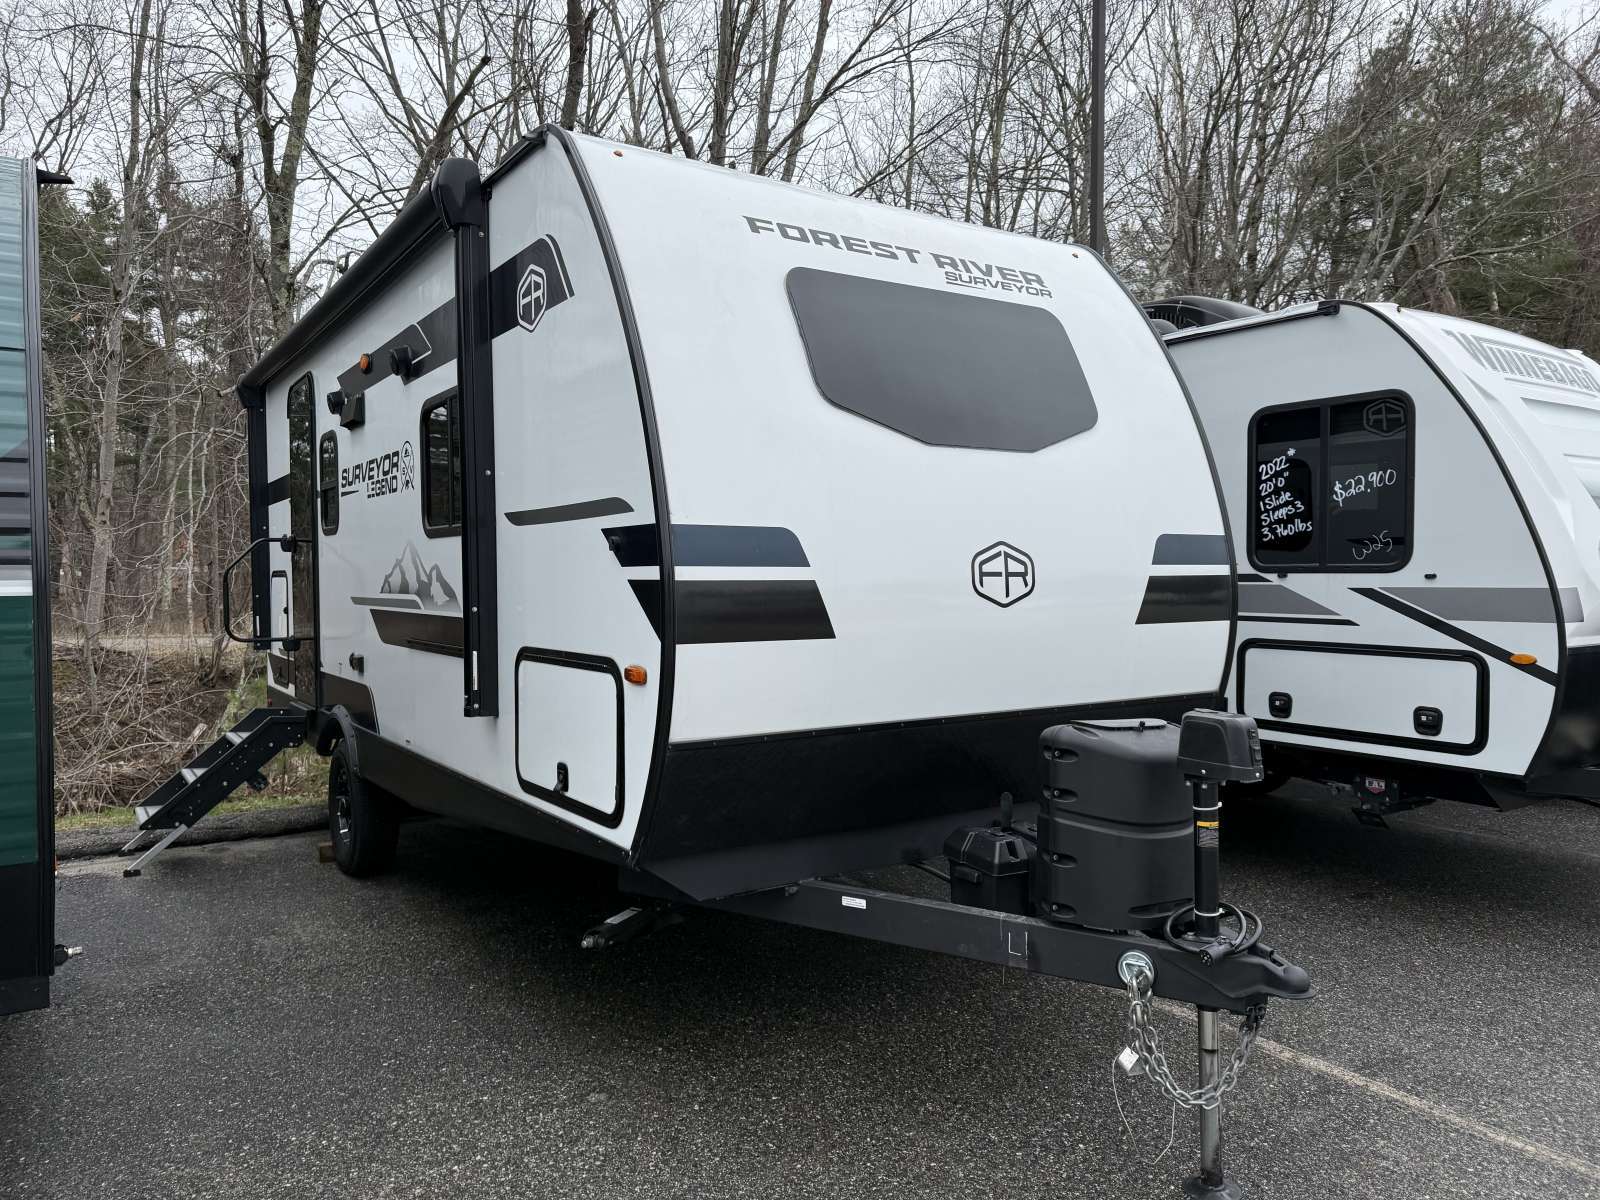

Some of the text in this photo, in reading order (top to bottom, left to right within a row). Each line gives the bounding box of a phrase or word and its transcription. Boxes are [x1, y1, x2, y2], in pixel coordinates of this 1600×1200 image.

[742, 215, 1047, 288] FOREST RIVER
[944, 270, 1053, 299] SURVEYOR
[341, 450, 400, 489] SURVEYOR
[367, 475, 398, 499] LEGEND
[1260, 501, 1305, 525] Sleeps 3
